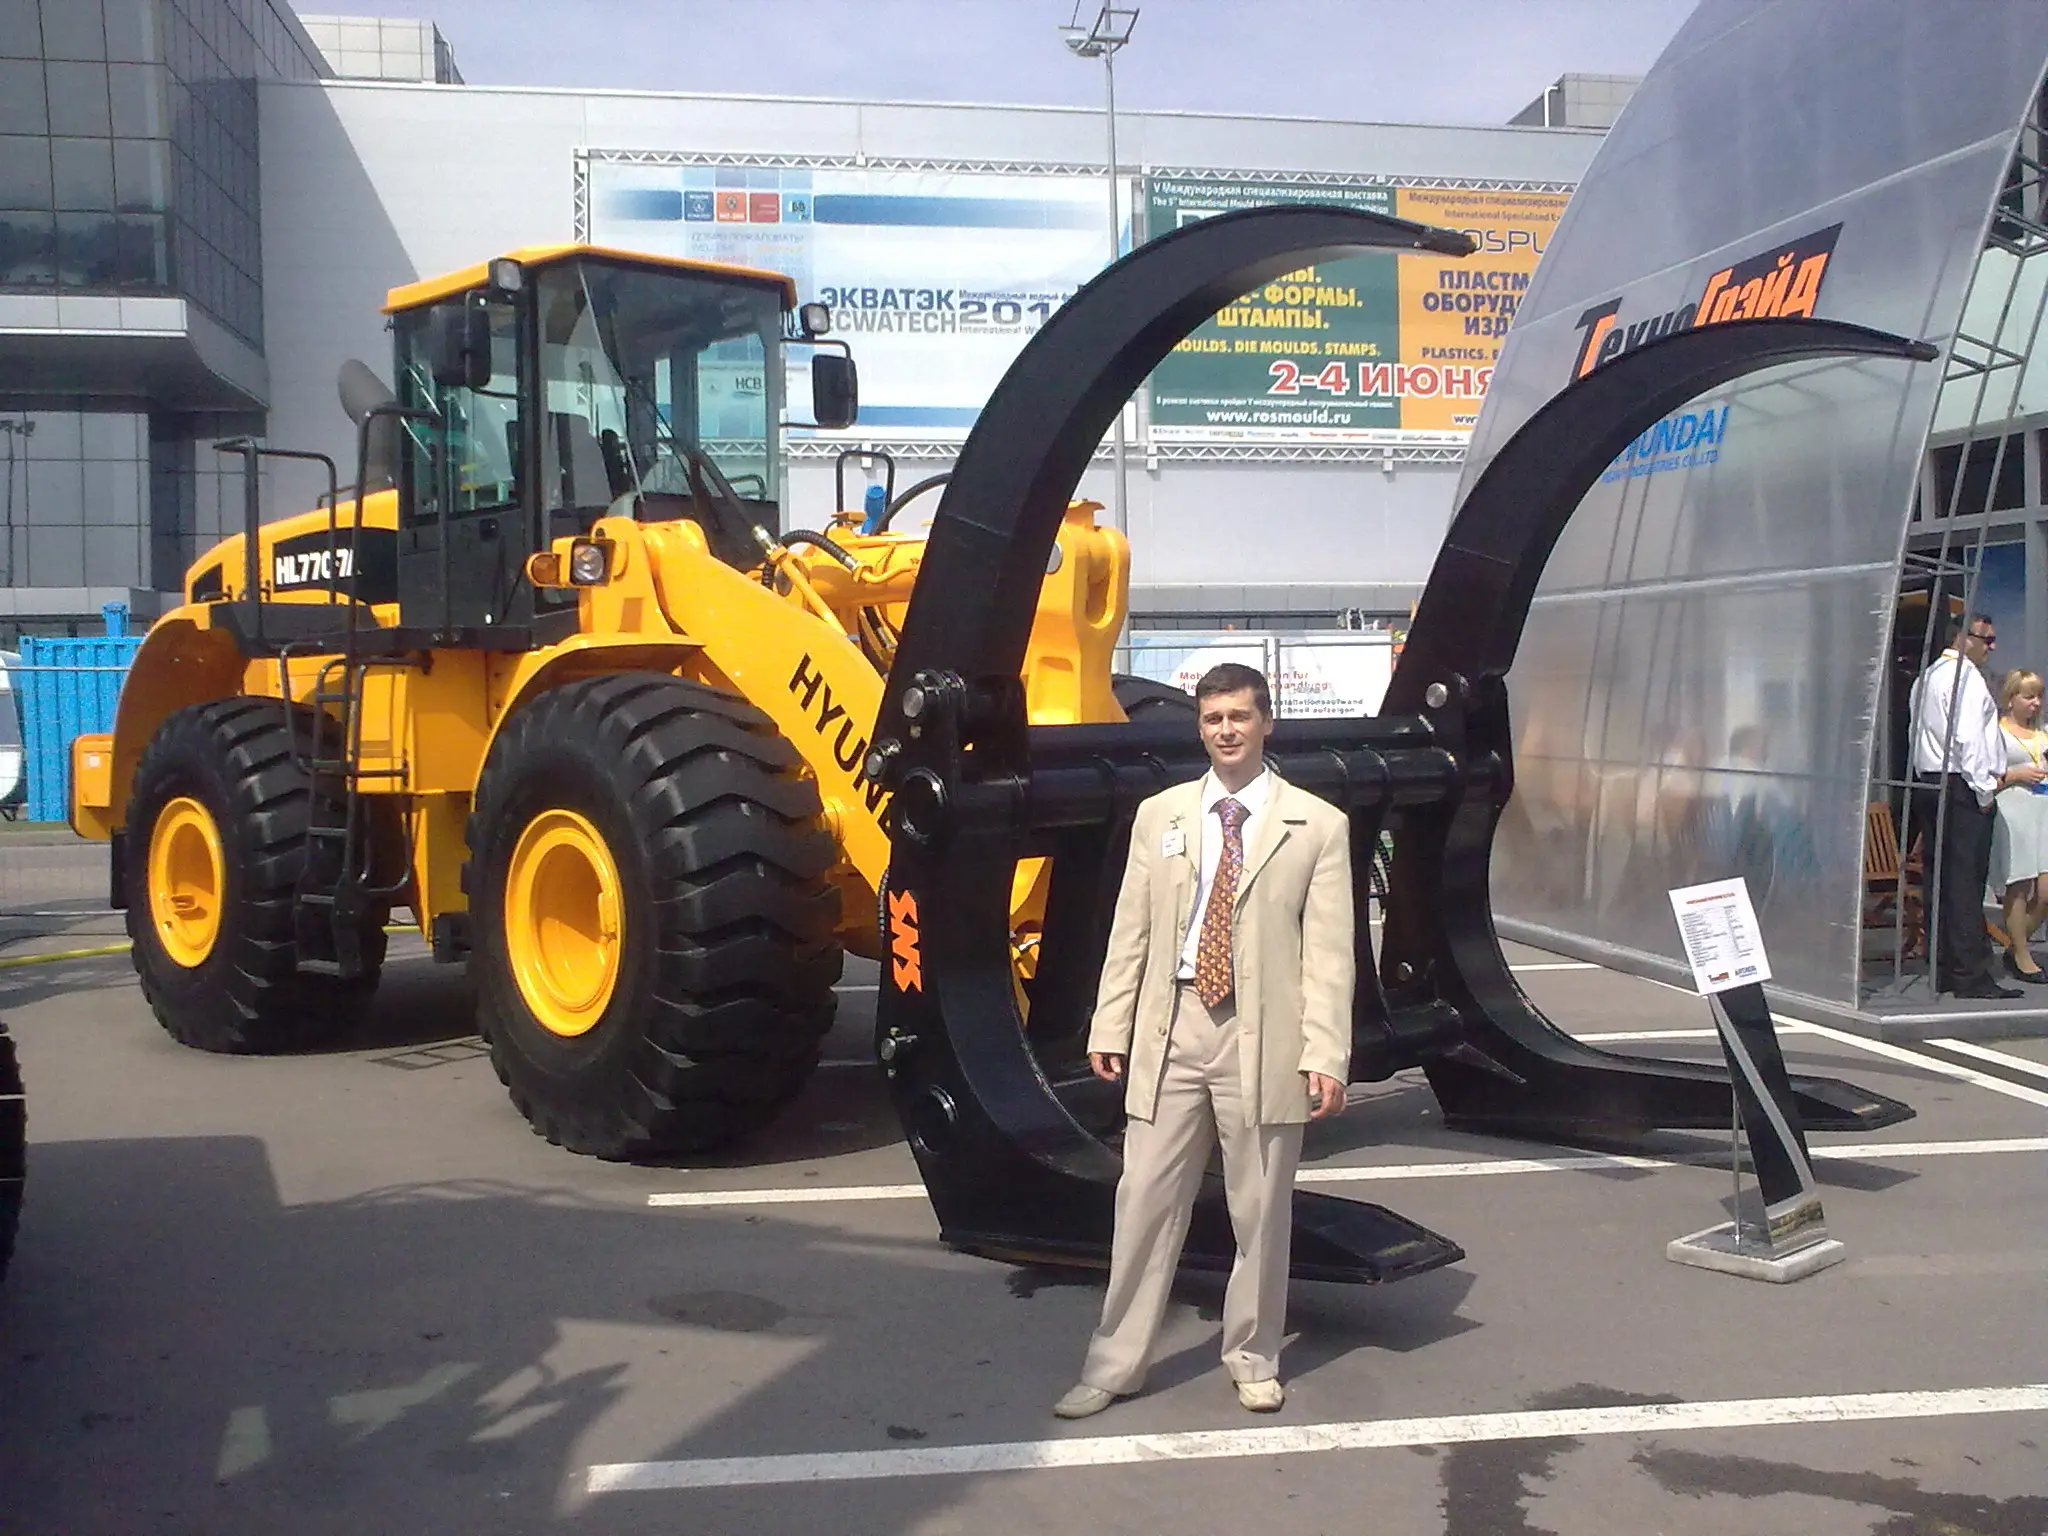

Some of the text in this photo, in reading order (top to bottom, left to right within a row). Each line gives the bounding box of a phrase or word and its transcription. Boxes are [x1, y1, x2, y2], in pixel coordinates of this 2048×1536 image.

[1162, 182, 1241, 197] Международная
[1243, 187, 1342, 200] специализированная
[1444, 209, 1500, 219] International
[820, 287, 955, 311] ЭКВАТЭК
[1216, 306, 1330, 330] ШТАМПЫ.
[1234, 340, 1258, 355] DIE
[1260, 342, 1322, 356] MOULDS.
[1324, 343, 1381, 357] STAMPS.
[1421, 346, 1489, 361] PLASTICS.
[1267, 360, 1349, 396] 2-4
[1207, 408, 1351, 425] www.rosmould.ru
